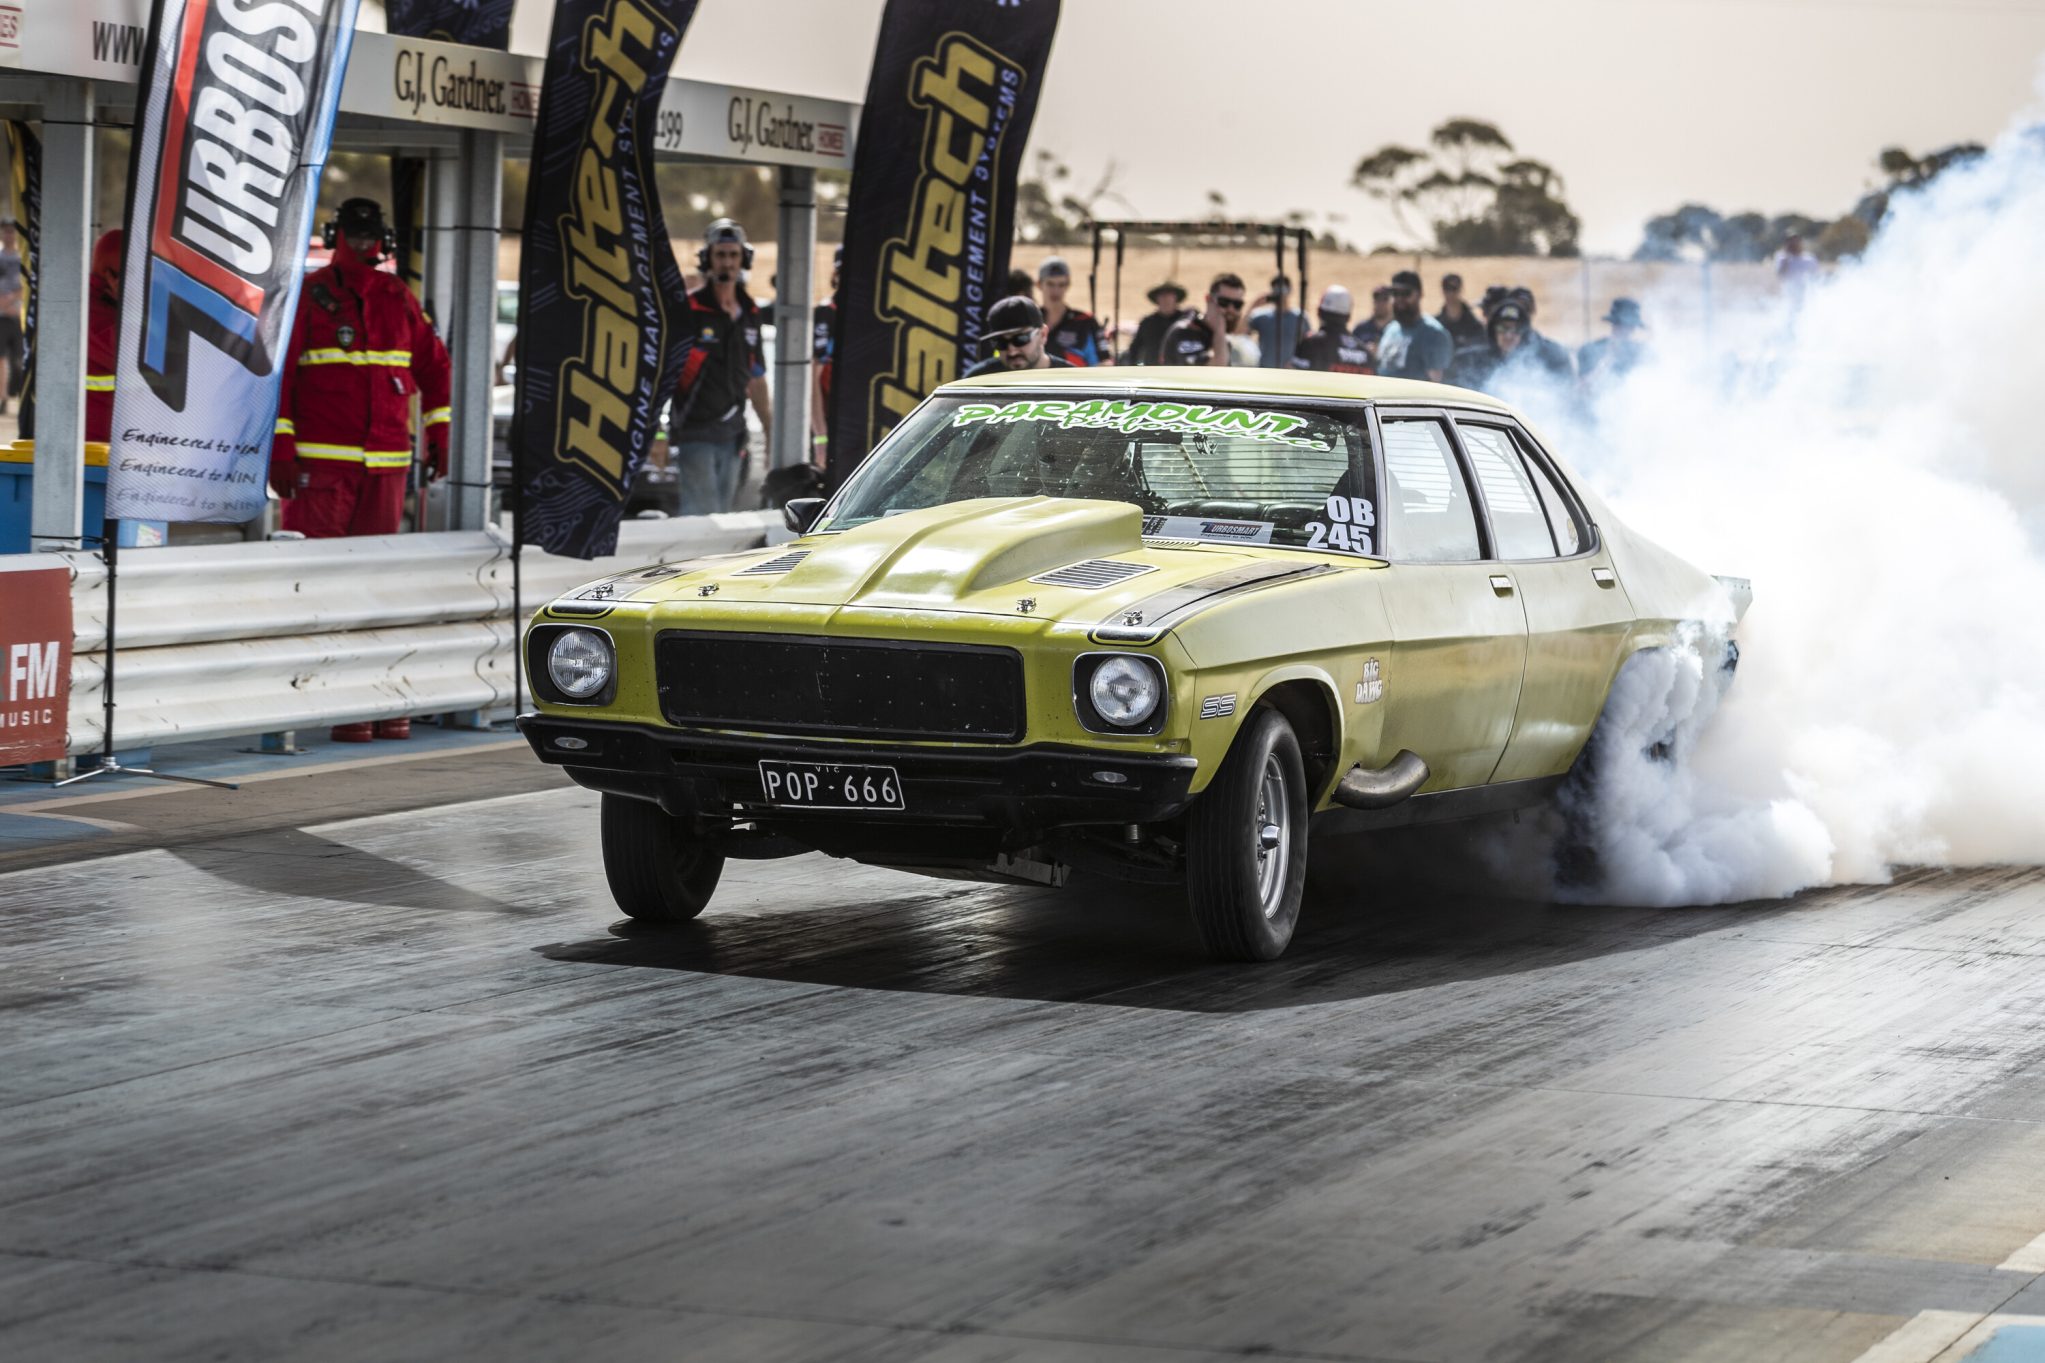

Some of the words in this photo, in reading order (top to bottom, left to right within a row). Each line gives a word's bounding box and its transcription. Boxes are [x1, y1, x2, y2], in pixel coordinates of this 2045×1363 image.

[953, 398, 1308, 434] PARAMOUNT
[121, 428, 213, 450] Engineered
[216, 440, 232, 453] to
[1061, 413, 1334, 452] Performance
[119, 458, 208, 478] Engineered
[208, 469, 222, 481] to
[1304, 522, 1373, 555] 245
[10, 641, 60, 701] FM
[1200, 692, 1237, 720] SS
[815, 765, 841, 774] VIC
